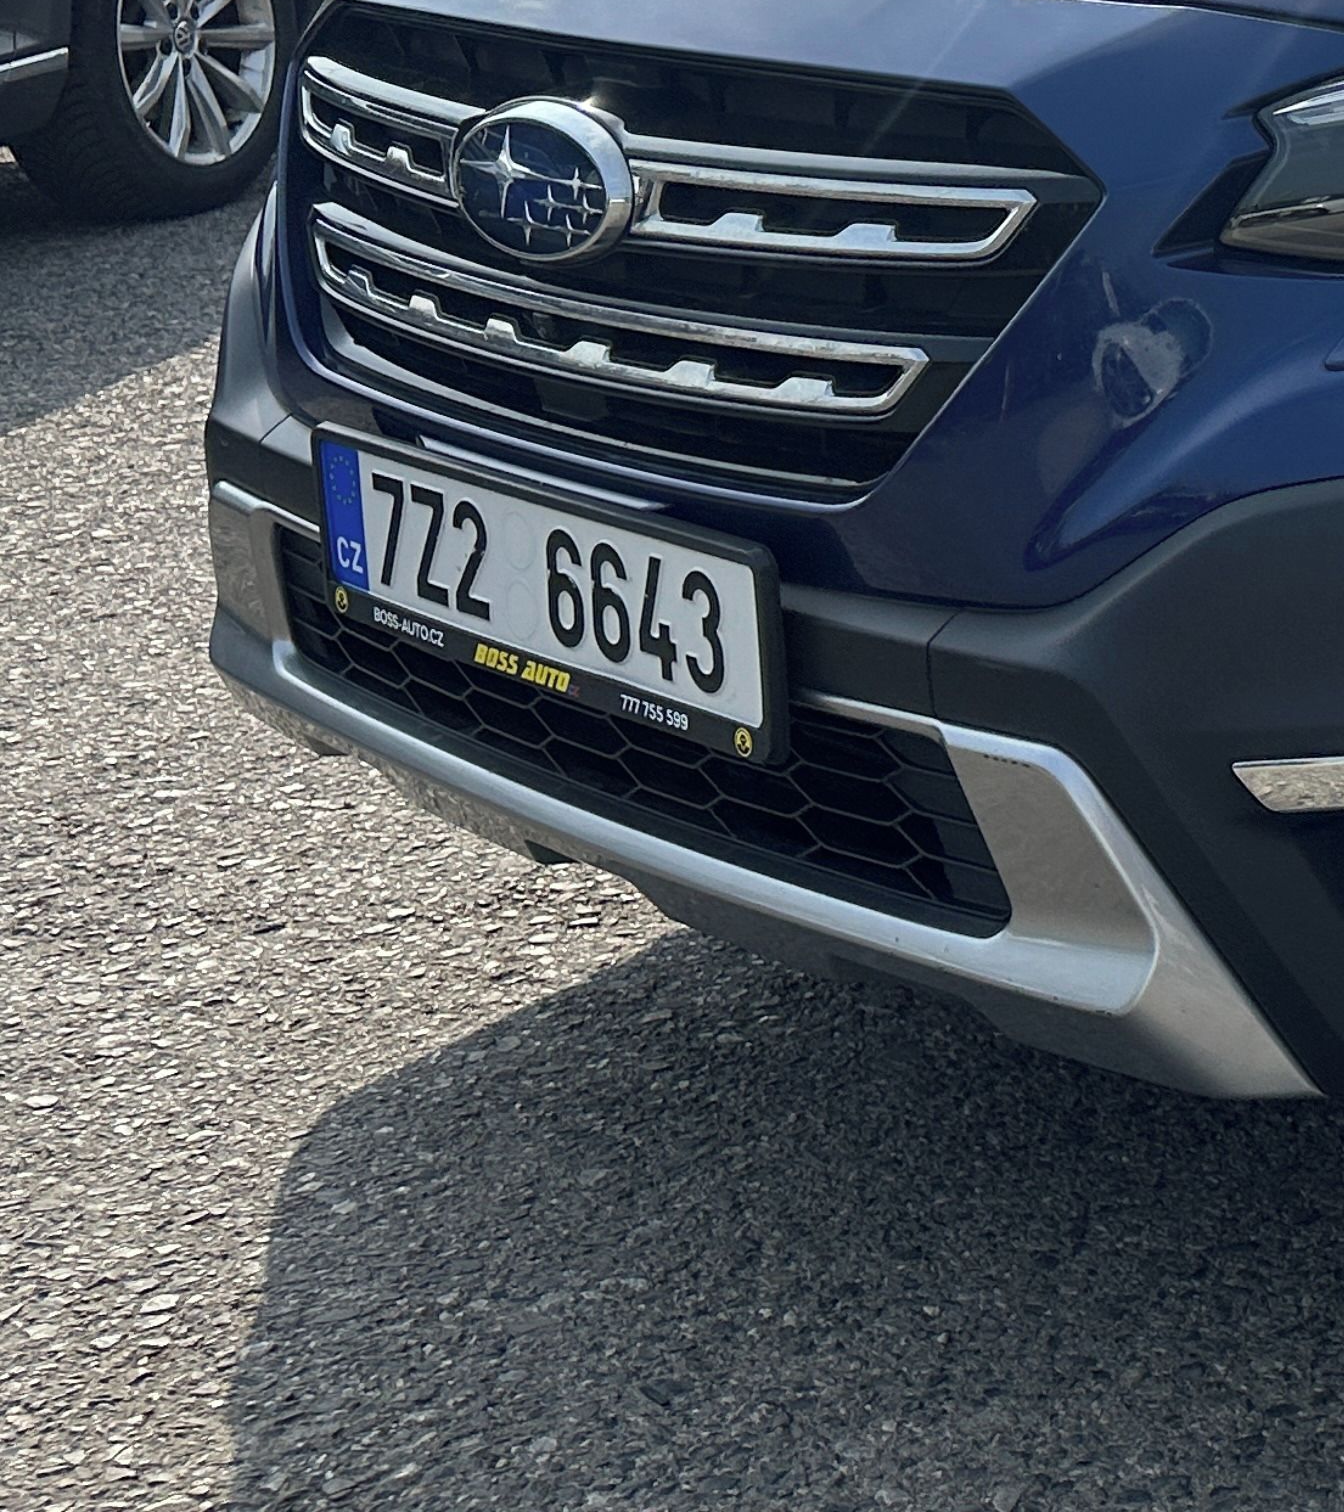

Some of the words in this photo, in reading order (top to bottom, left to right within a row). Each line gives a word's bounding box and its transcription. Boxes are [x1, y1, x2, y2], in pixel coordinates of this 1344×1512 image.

[337, 536, 363, 574] CZ
[370, 472, 491, 622] 7Z2
[545, 528, 725, 694] 6643
[373, 606, 445, 647] BOSS-AUTO.CZ
[474, 642, 520, 675] BOSS
[620, 694, 640, 715] 777
[642, 701, 664, 723] 755
[666, 709, 689, 731] 599
